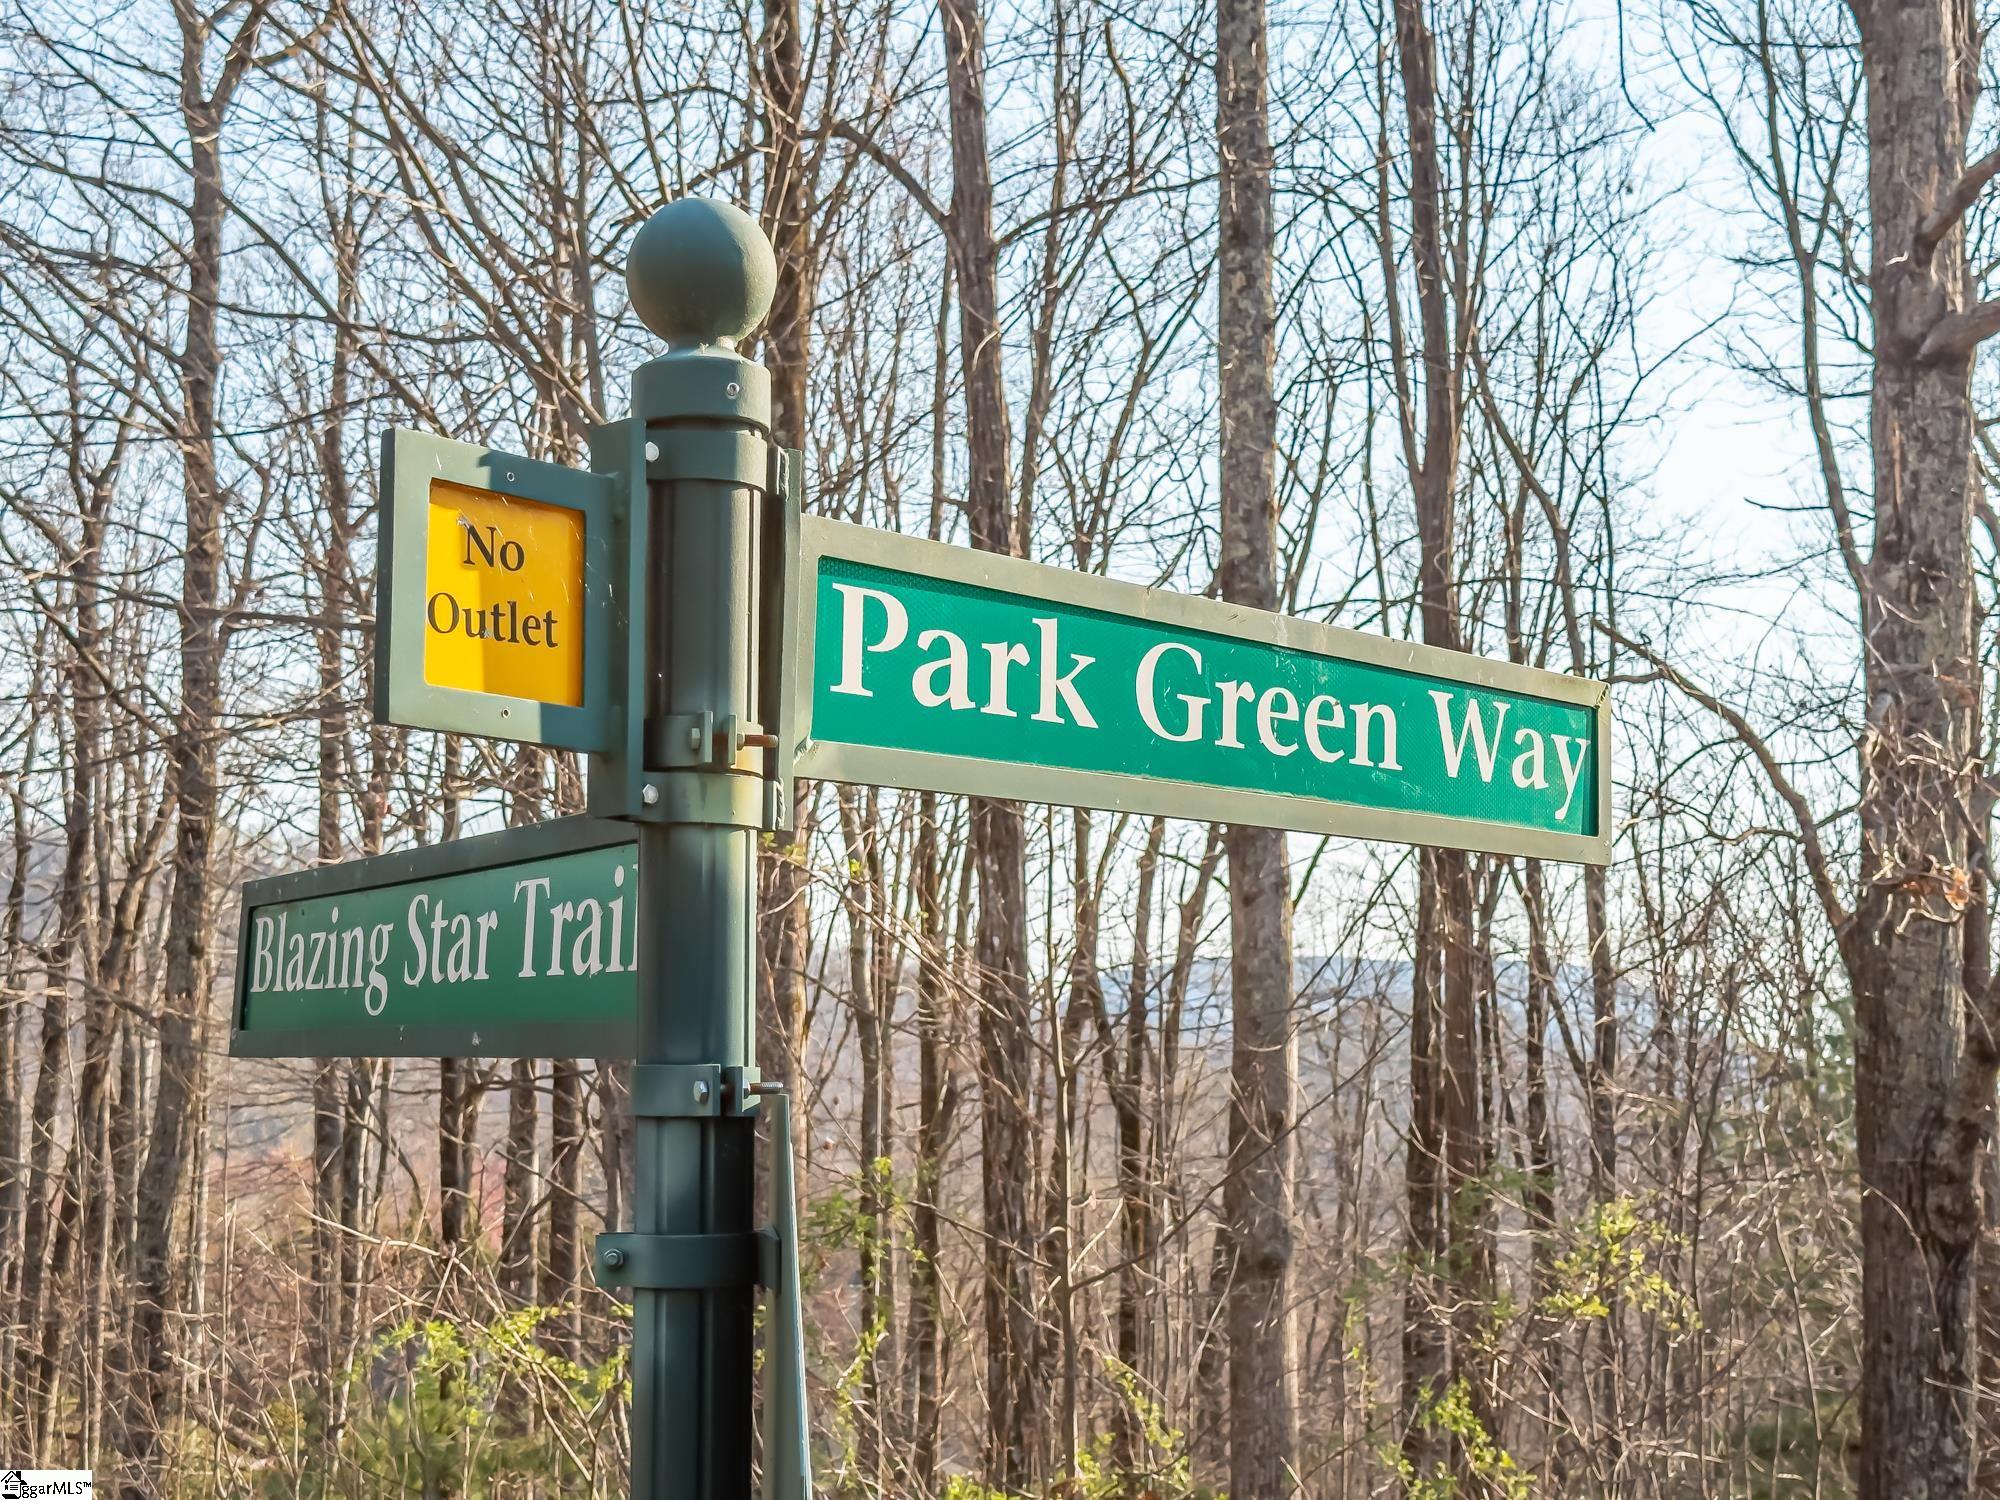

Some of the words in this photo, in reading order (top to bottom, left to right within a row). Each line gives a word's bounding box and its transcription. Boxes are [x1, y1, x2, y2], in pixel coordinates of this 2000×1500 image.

[464, 526, 525, 572] No
[427, 592, 558, 649] Outlet
[829, 582, 1099, 729] Park
[1135, 642, 1403, 771] Green
[1428, 690, 1590, 820] Way
[250, 906, 394, 1016] Blazing
[403, 894, 498, 986] Star
